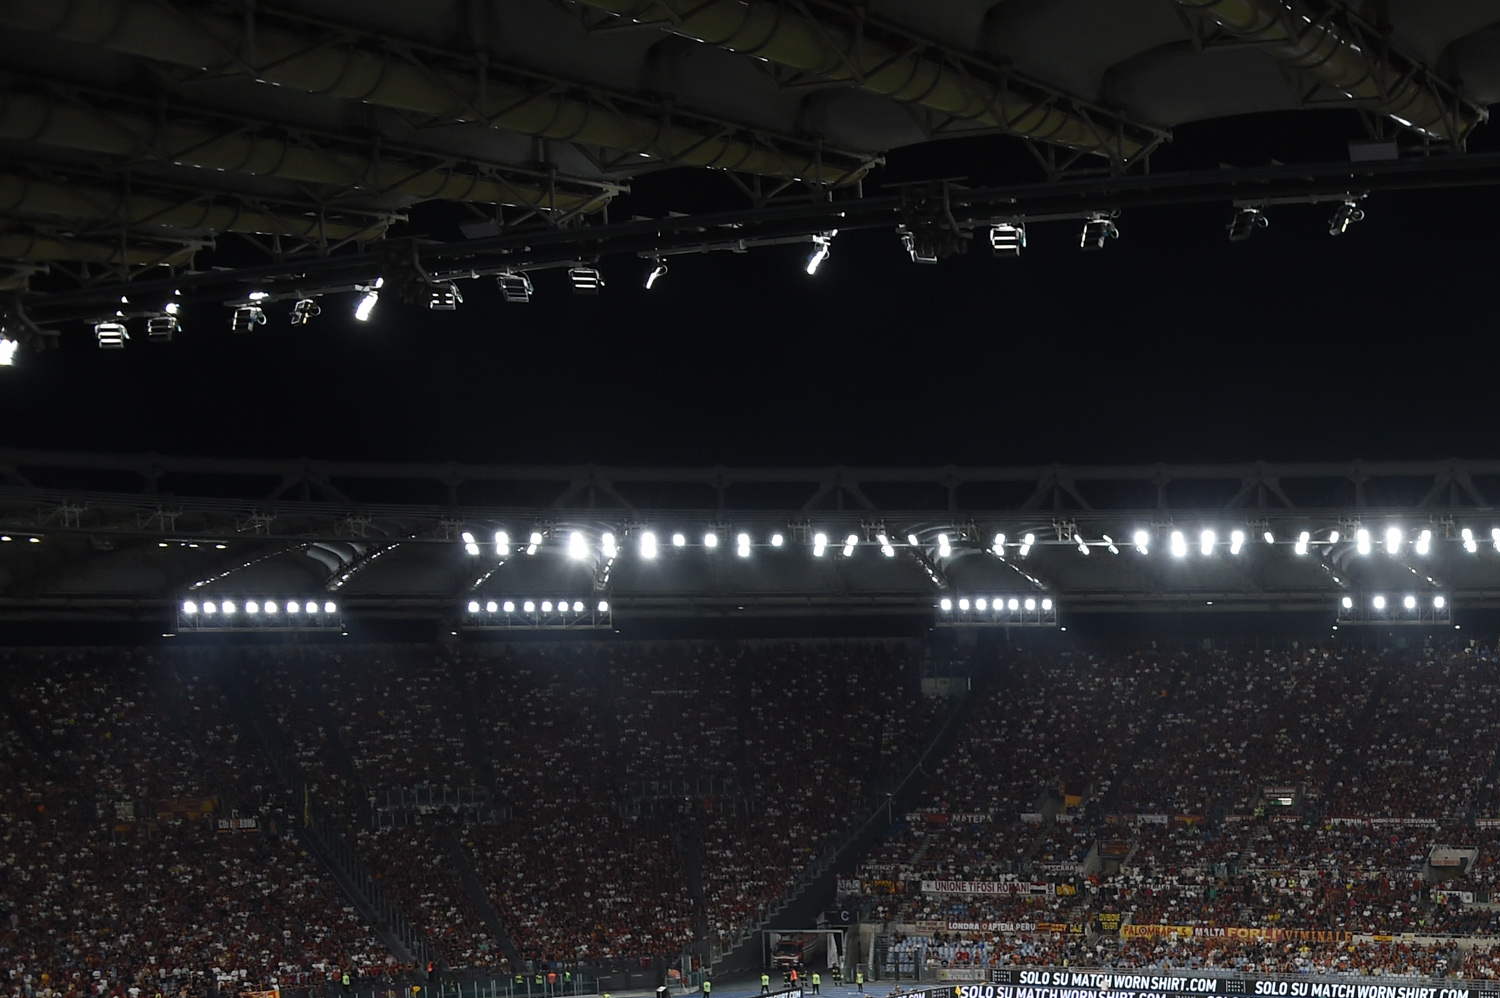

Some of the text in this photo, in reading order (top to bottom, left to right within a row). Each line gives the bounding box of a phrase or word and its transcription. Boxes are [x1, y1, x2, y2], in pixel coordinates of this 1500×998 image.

[935, 881, 1030, 893] UNIONE TIFOSI ROANI
[841, 911, 850, 921] C
[949, 922, 979, 930] LONDRA
[1016, 922, 1036, 931] PERU
[1195, 928, 1225, 937] MALTA
[1284, 930, 1353, 943] VIMINALE
[1019, 971, 1050, 984] SOLO
[1052, 973, 1069, 986] SU
[1255, 981, 1286, 995] SOLO
[1291, 982, 1308, 996] SU
